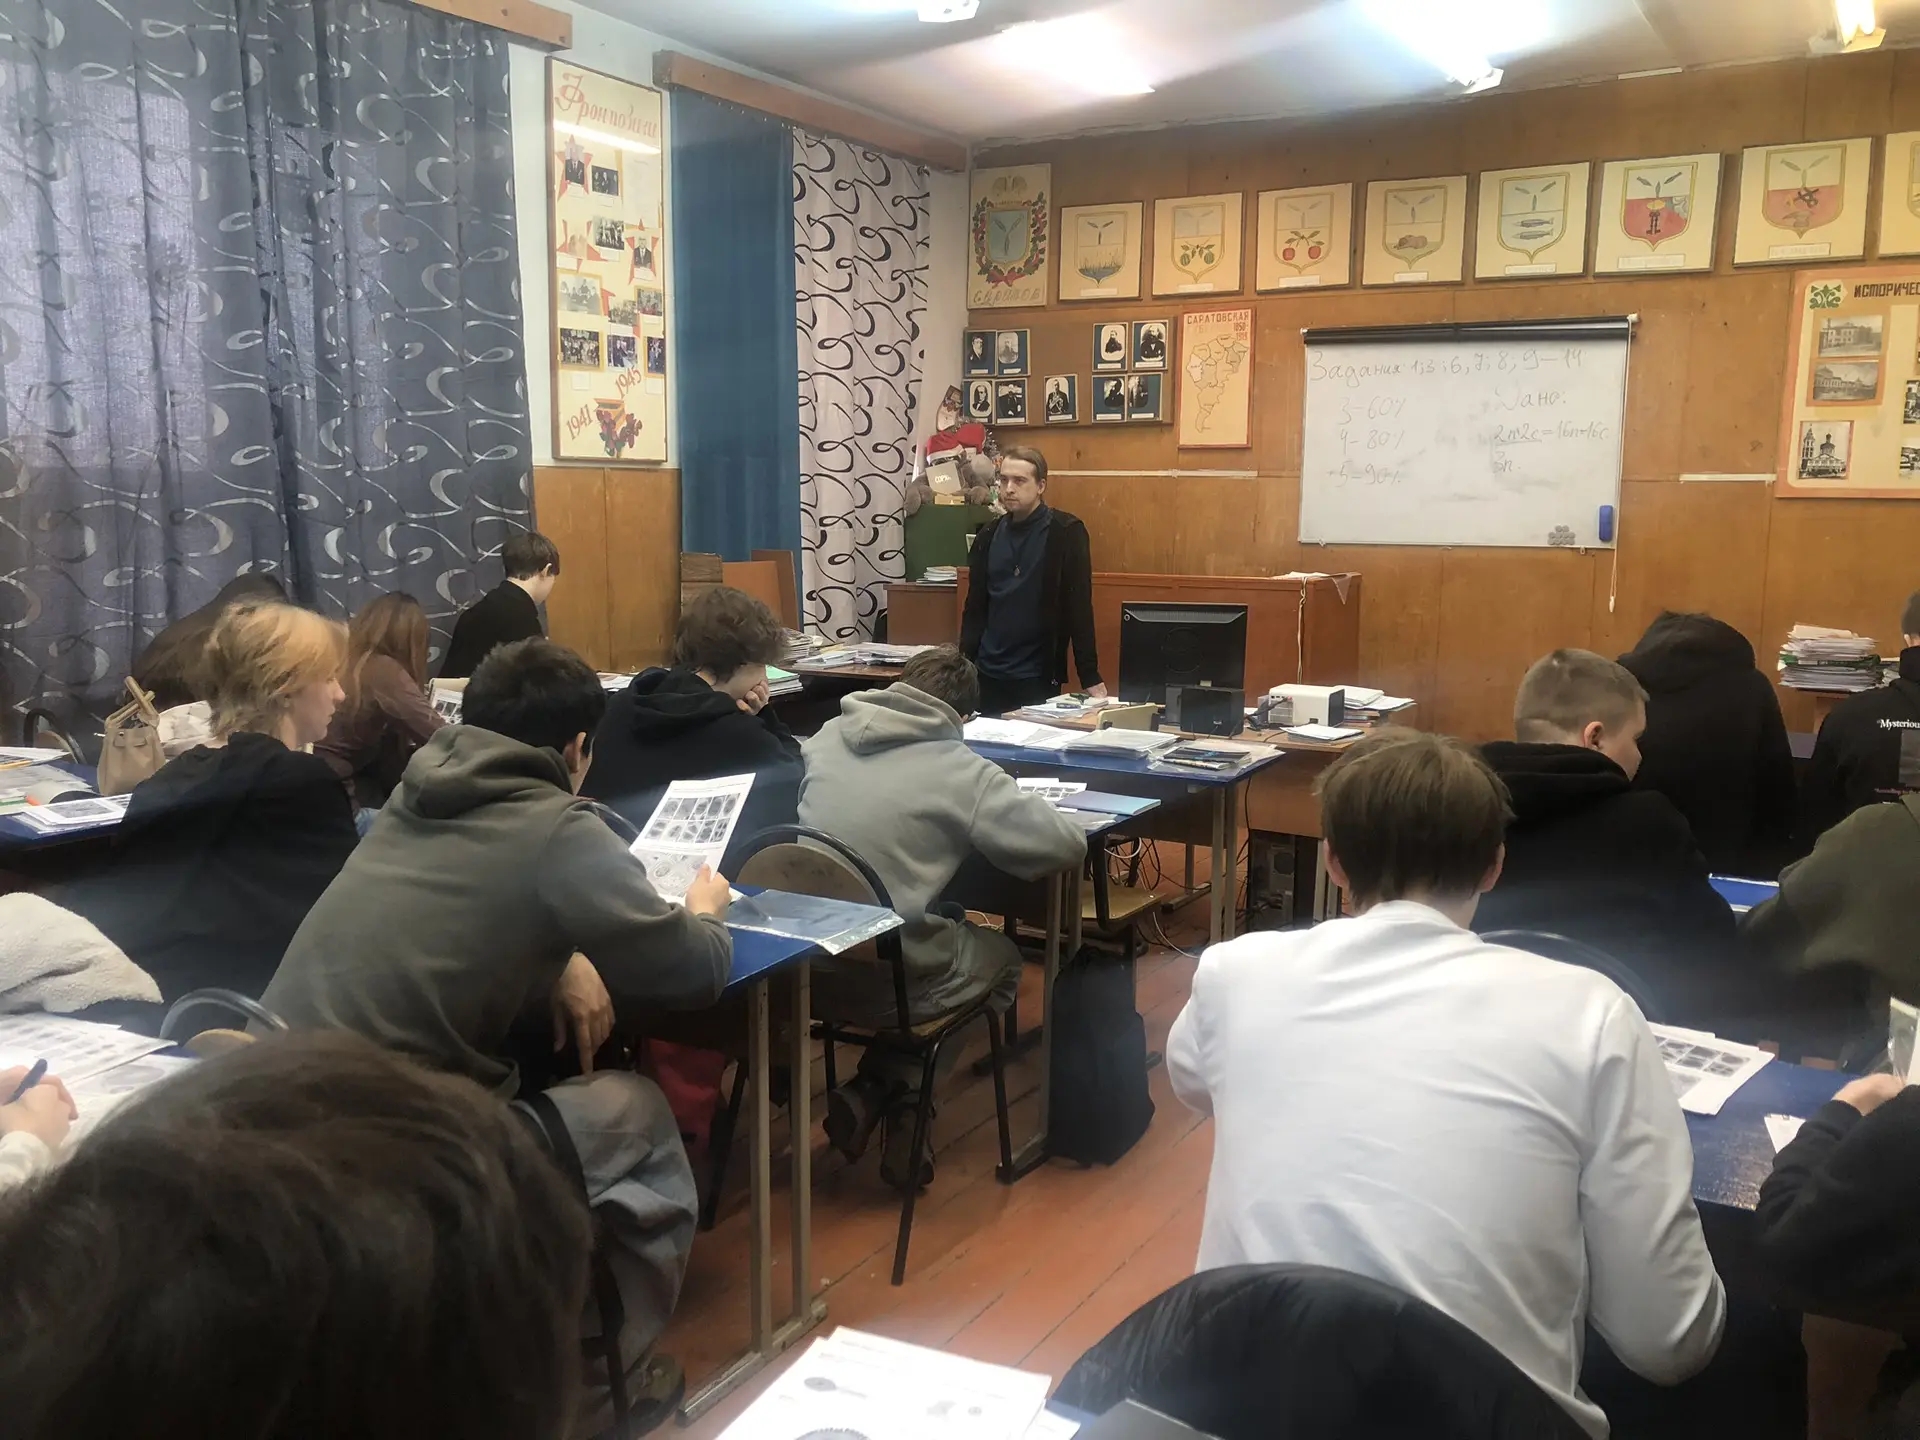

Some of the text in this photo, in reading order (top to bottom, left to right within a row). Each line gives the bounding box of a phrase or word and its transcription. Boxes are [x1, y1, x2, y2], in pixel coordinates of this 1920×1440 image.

[1187, 311, 1249, 324] САРАТОВСКАЯ
[615, 365, 642, 400] 1945
[566, 403, 593, 440] 1941
